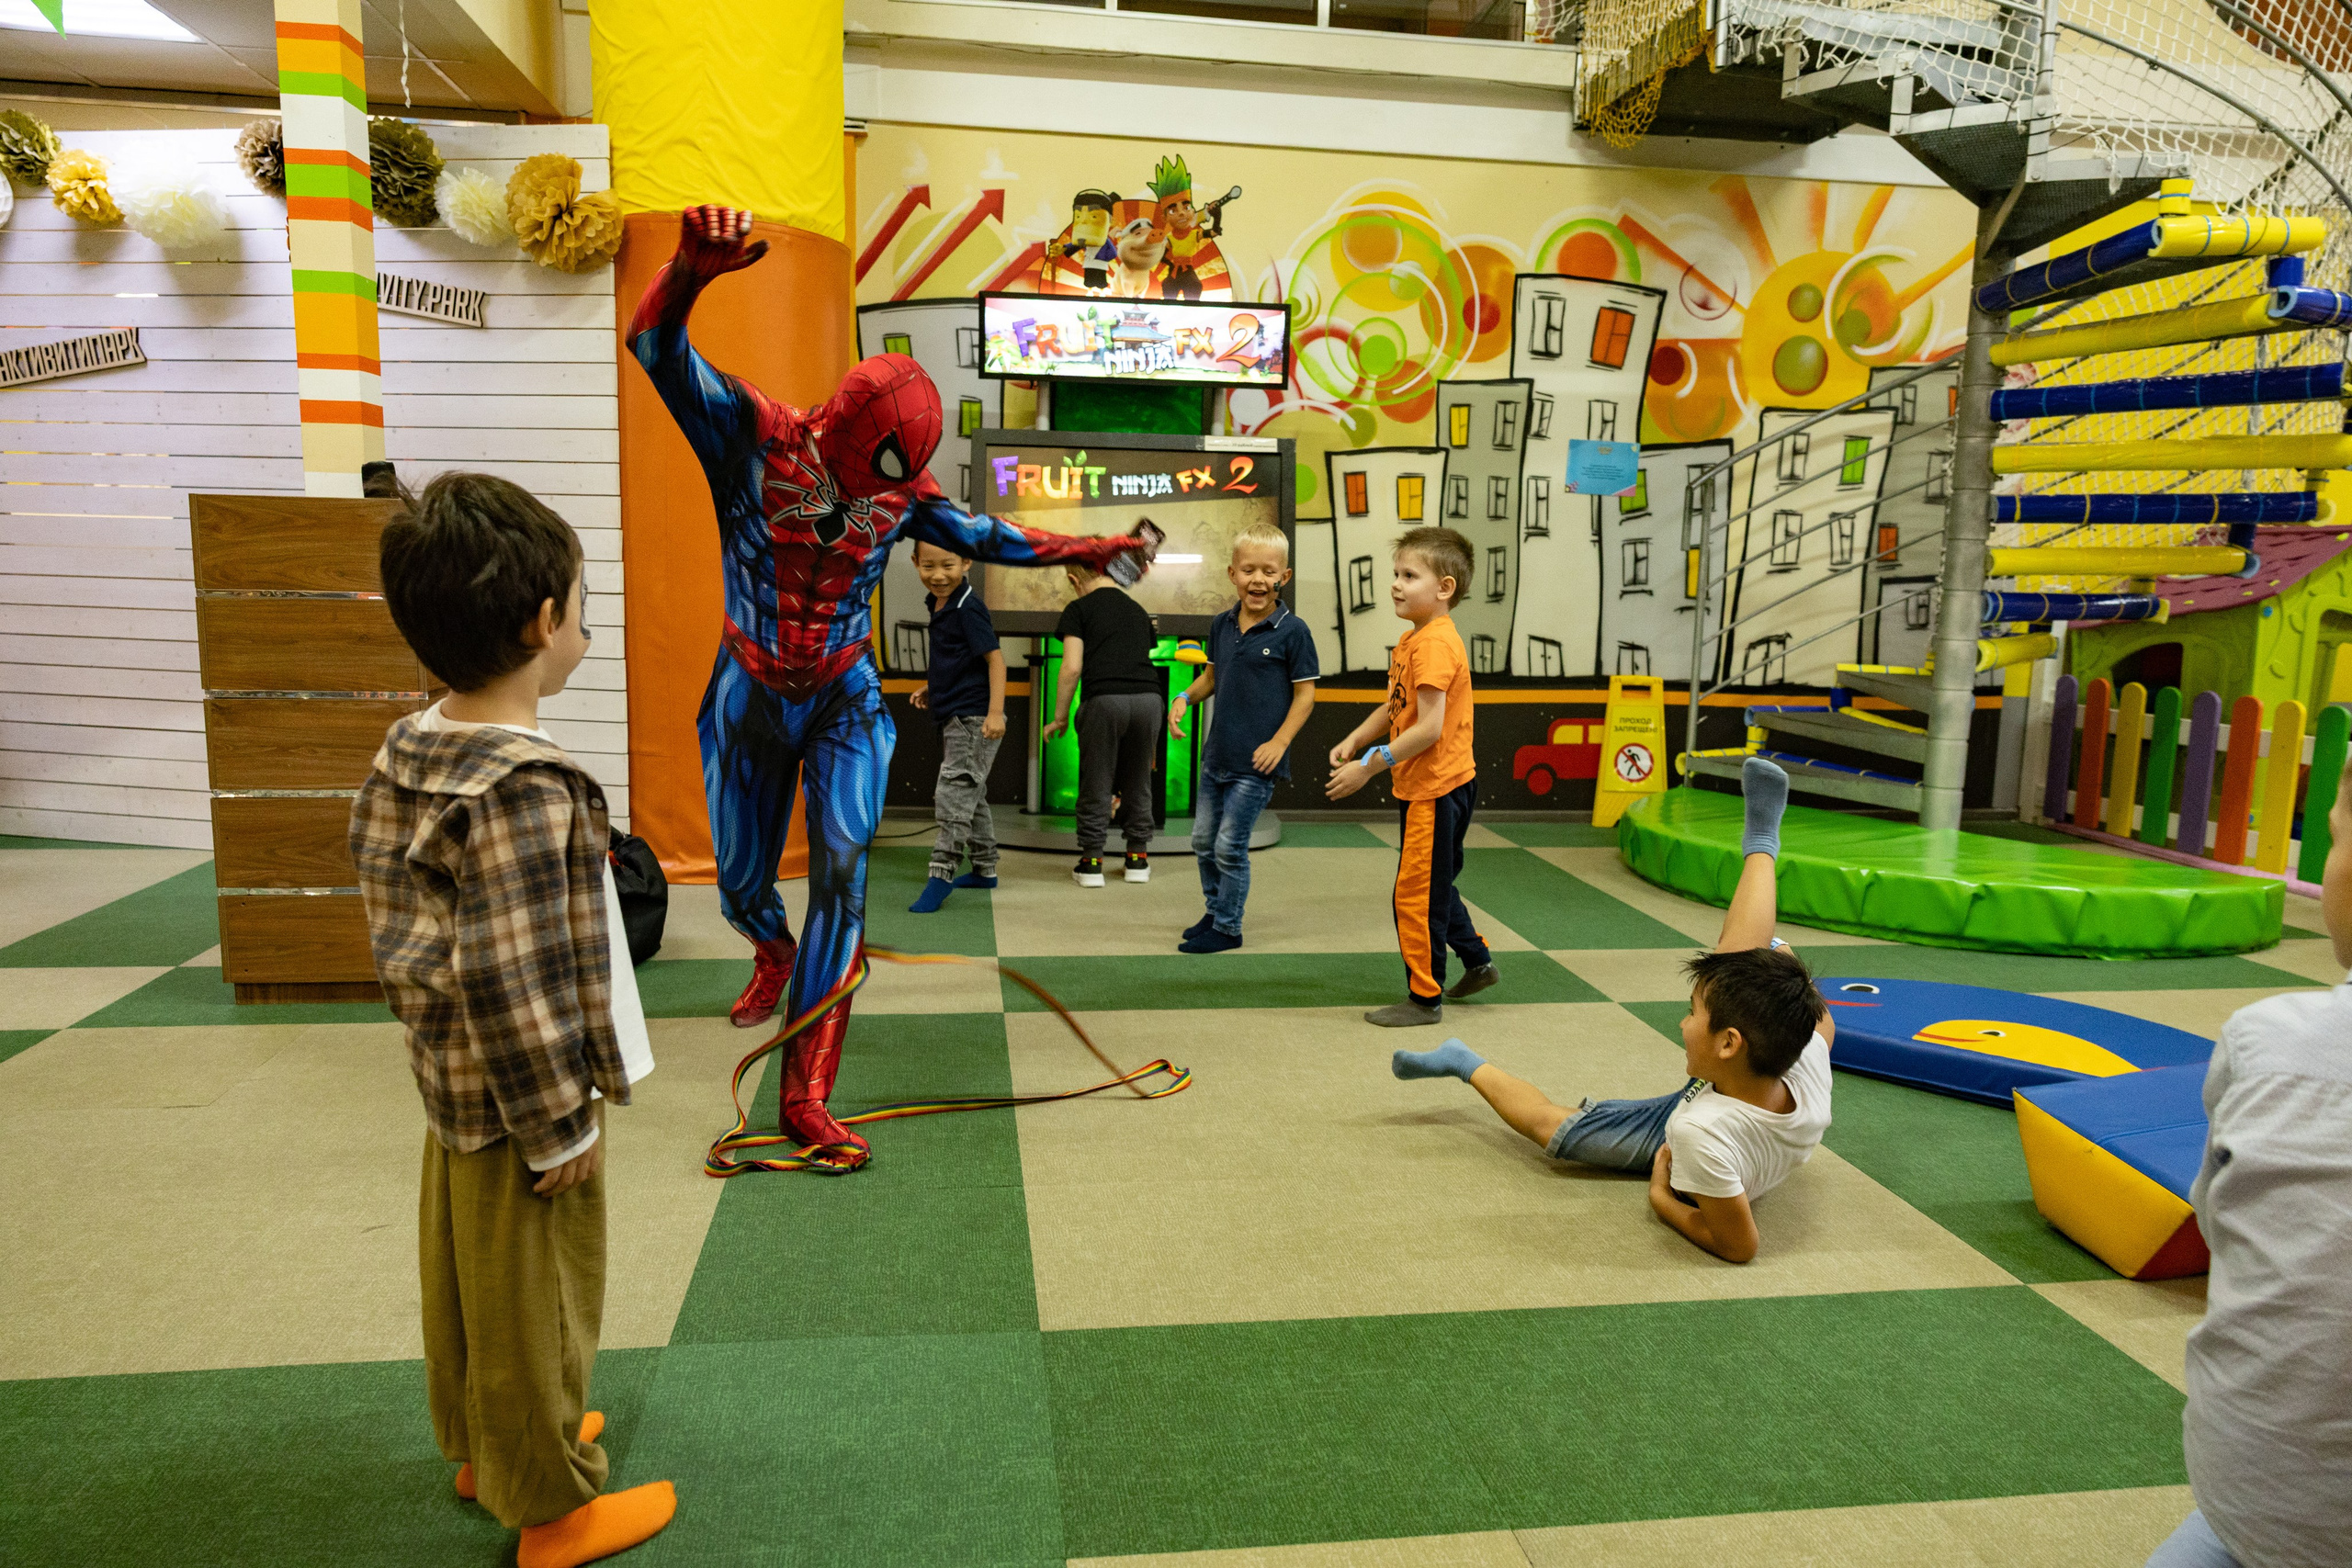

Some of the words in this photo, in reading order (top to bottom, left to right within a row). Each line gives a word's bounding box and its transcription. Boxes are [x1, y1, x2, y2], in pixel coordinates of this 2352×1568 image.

[377, 272, 486, 324] VITY.PARK
[1012, 317, 1118, 357] FRUIT
[1103, 344, 1175, 375] NINJA
[1174, 327, 1214, 356] FX
[1216, 313, 1261, 368] 2
[991, 456, 1106, 500] FRUIT
[1112, 472, 1173, 498] NINJA
[1176, 466, 1217, 493] FX
[1221, 456, 1259, 494] 2
[1619, 716, 1652, 725] ПРОХОД
